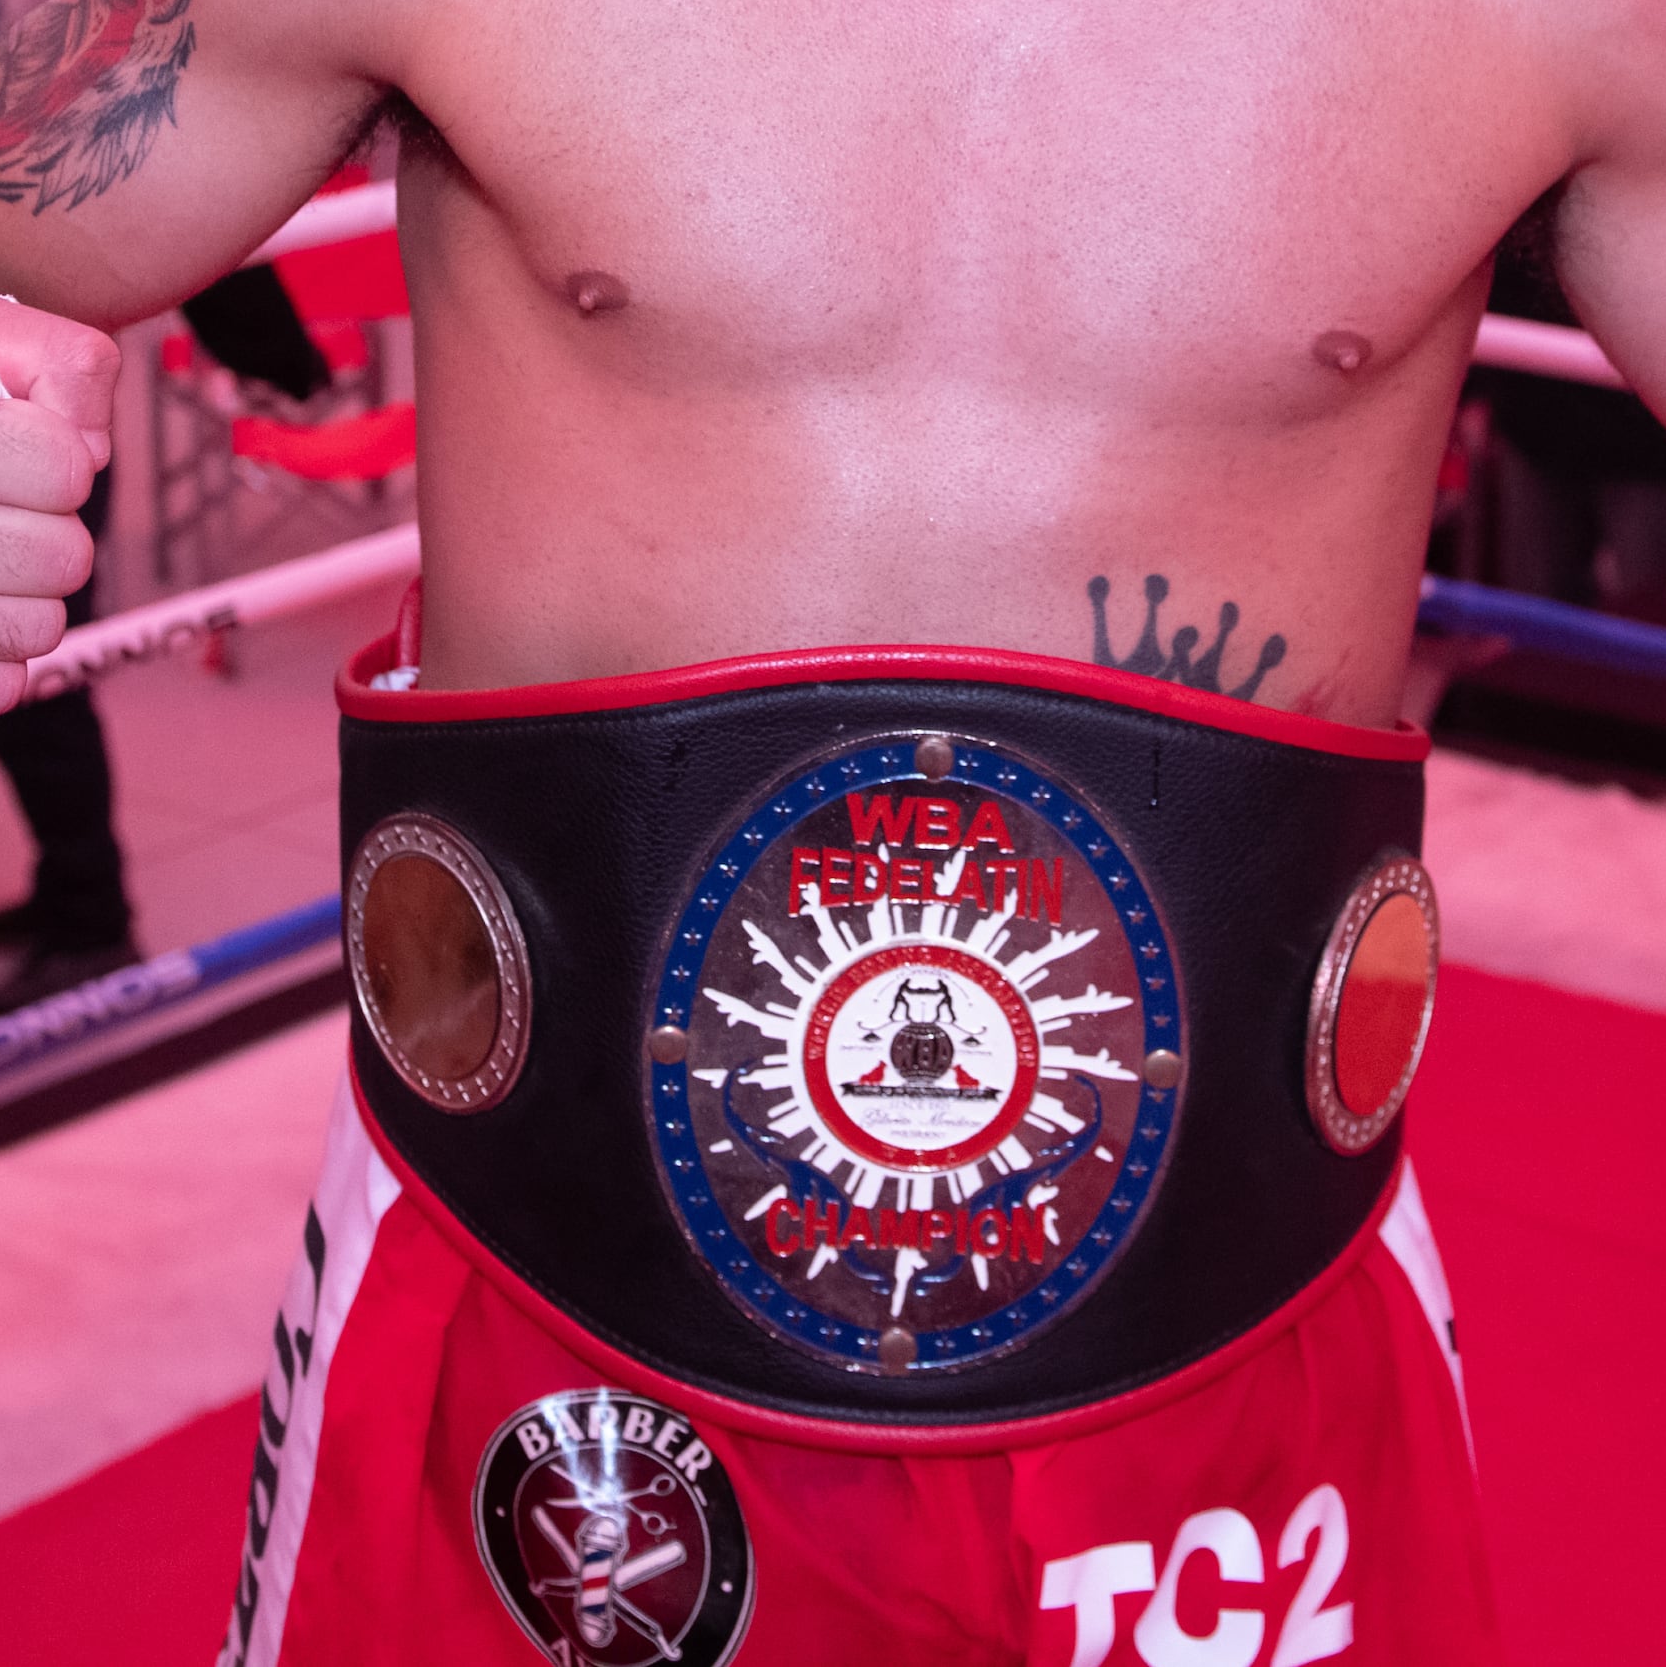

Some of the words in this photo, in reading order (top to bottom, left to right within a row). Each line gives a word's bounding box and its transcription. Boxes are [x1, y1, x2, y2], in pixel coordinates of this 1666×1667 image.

[846, 792, 1016, 854] WBA
[788, 845, 1064, 927] FEDELATIN
[765, 1195, 1046, 1265] CHAMPION
[1038, 1482, 1355, 1667] TC2
